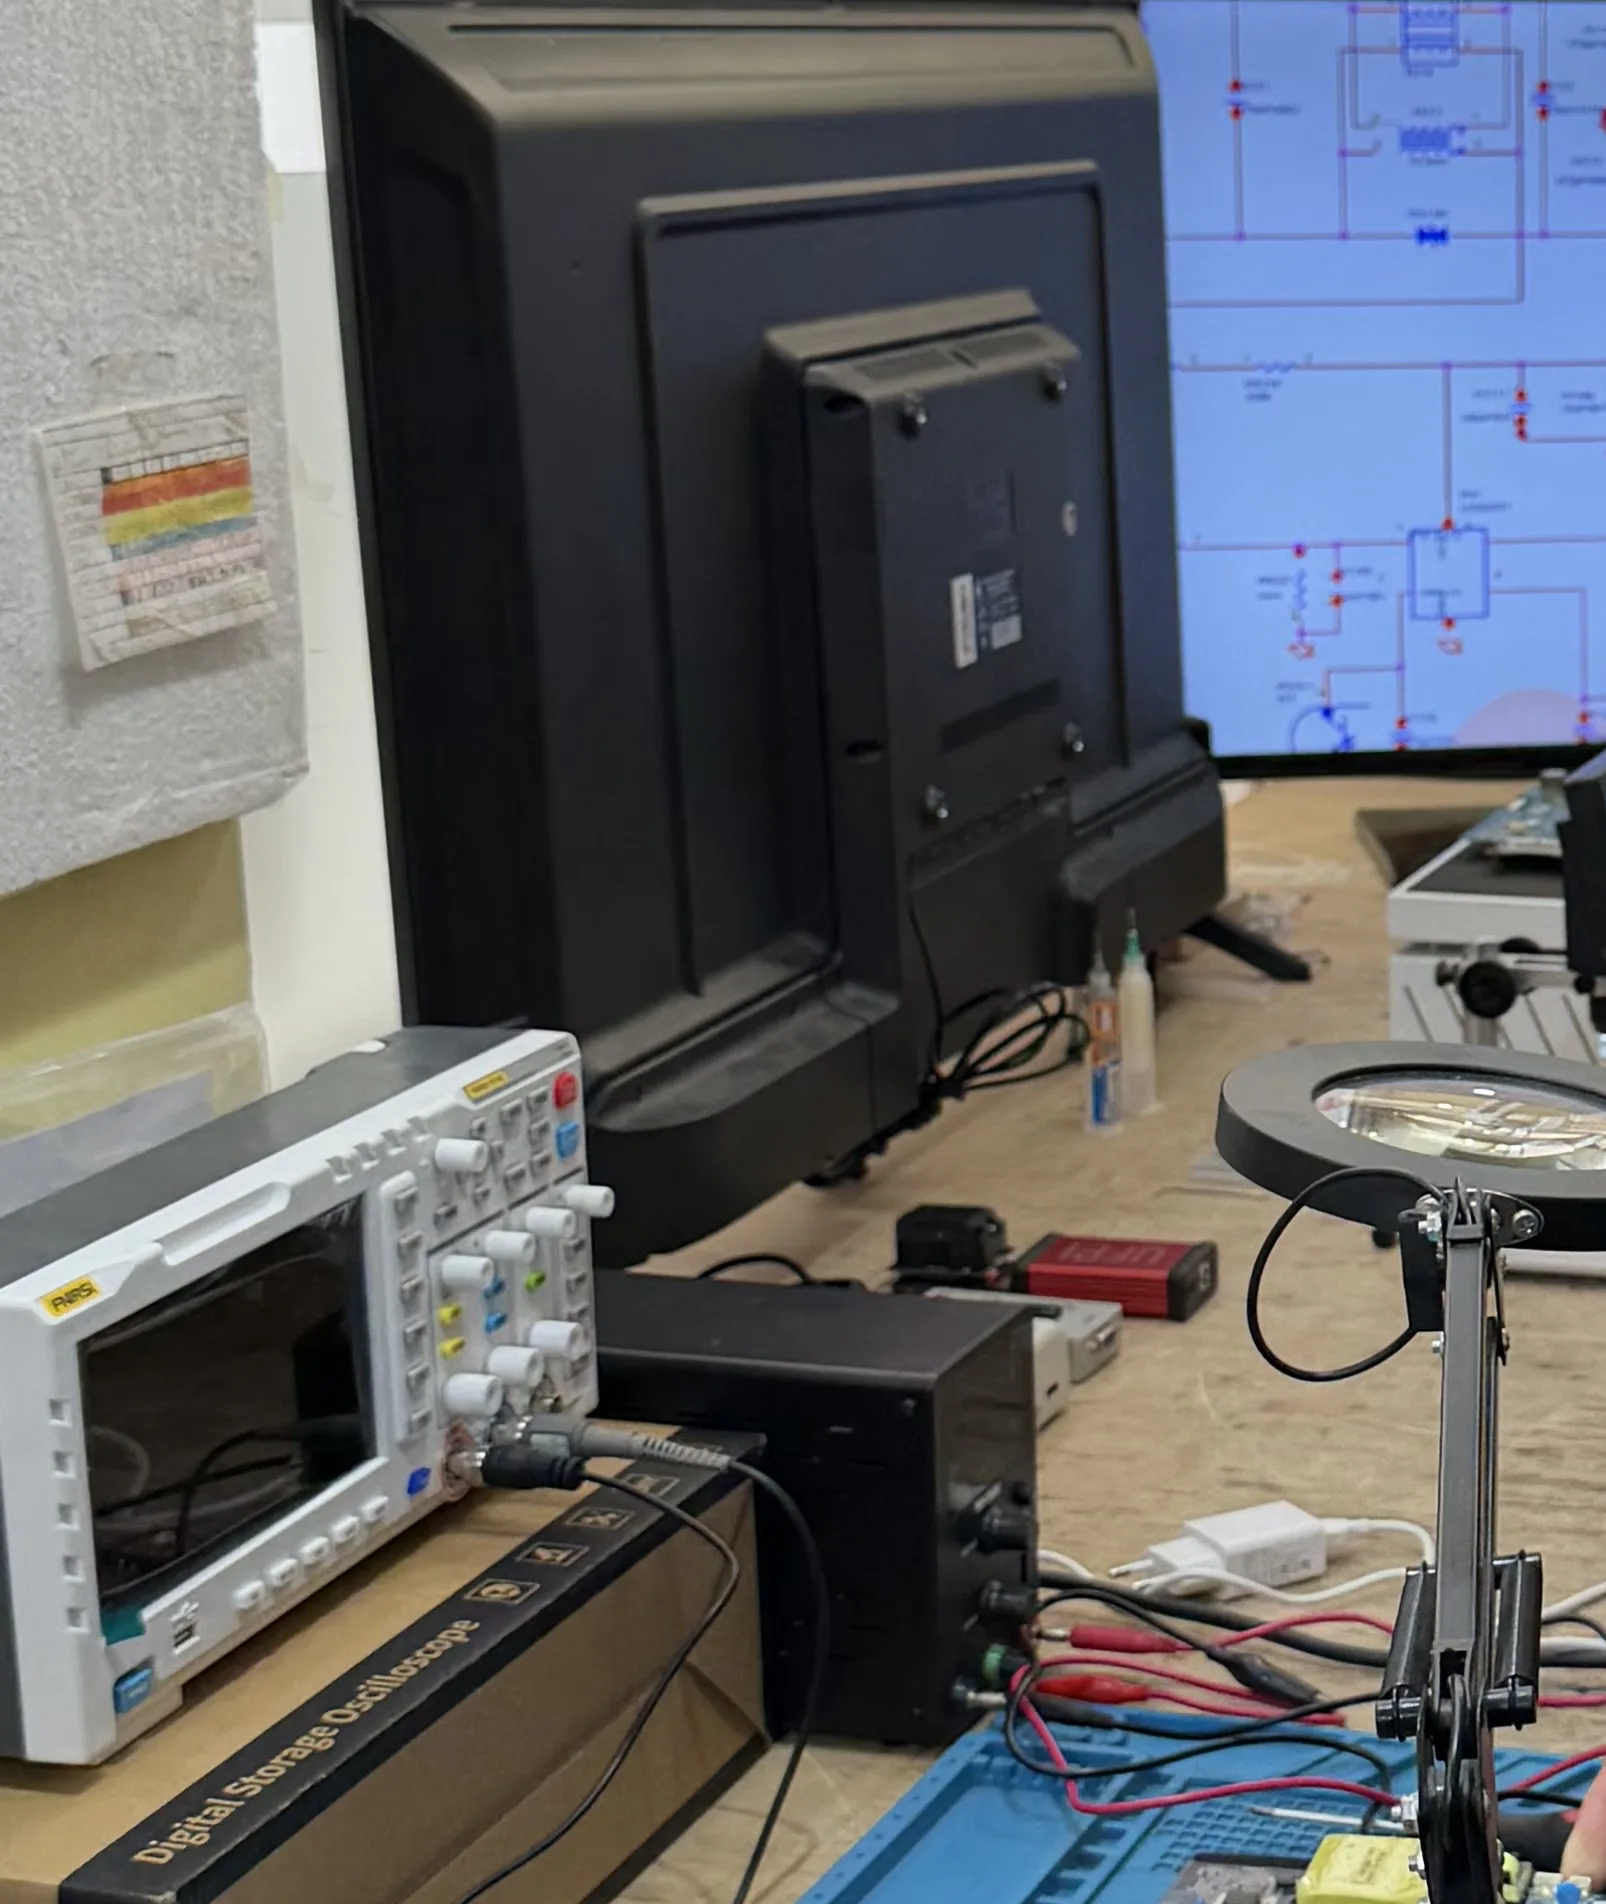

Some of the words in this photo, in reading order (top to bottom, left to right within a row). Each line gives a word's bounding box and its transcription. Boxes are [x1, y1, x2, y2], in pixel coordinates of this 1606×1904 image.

[130, 1797, 246, 1865] Digital
[222, 1724, 340, 1797] Storage
[319, 1618, 481, 1726] Oscilloscope
